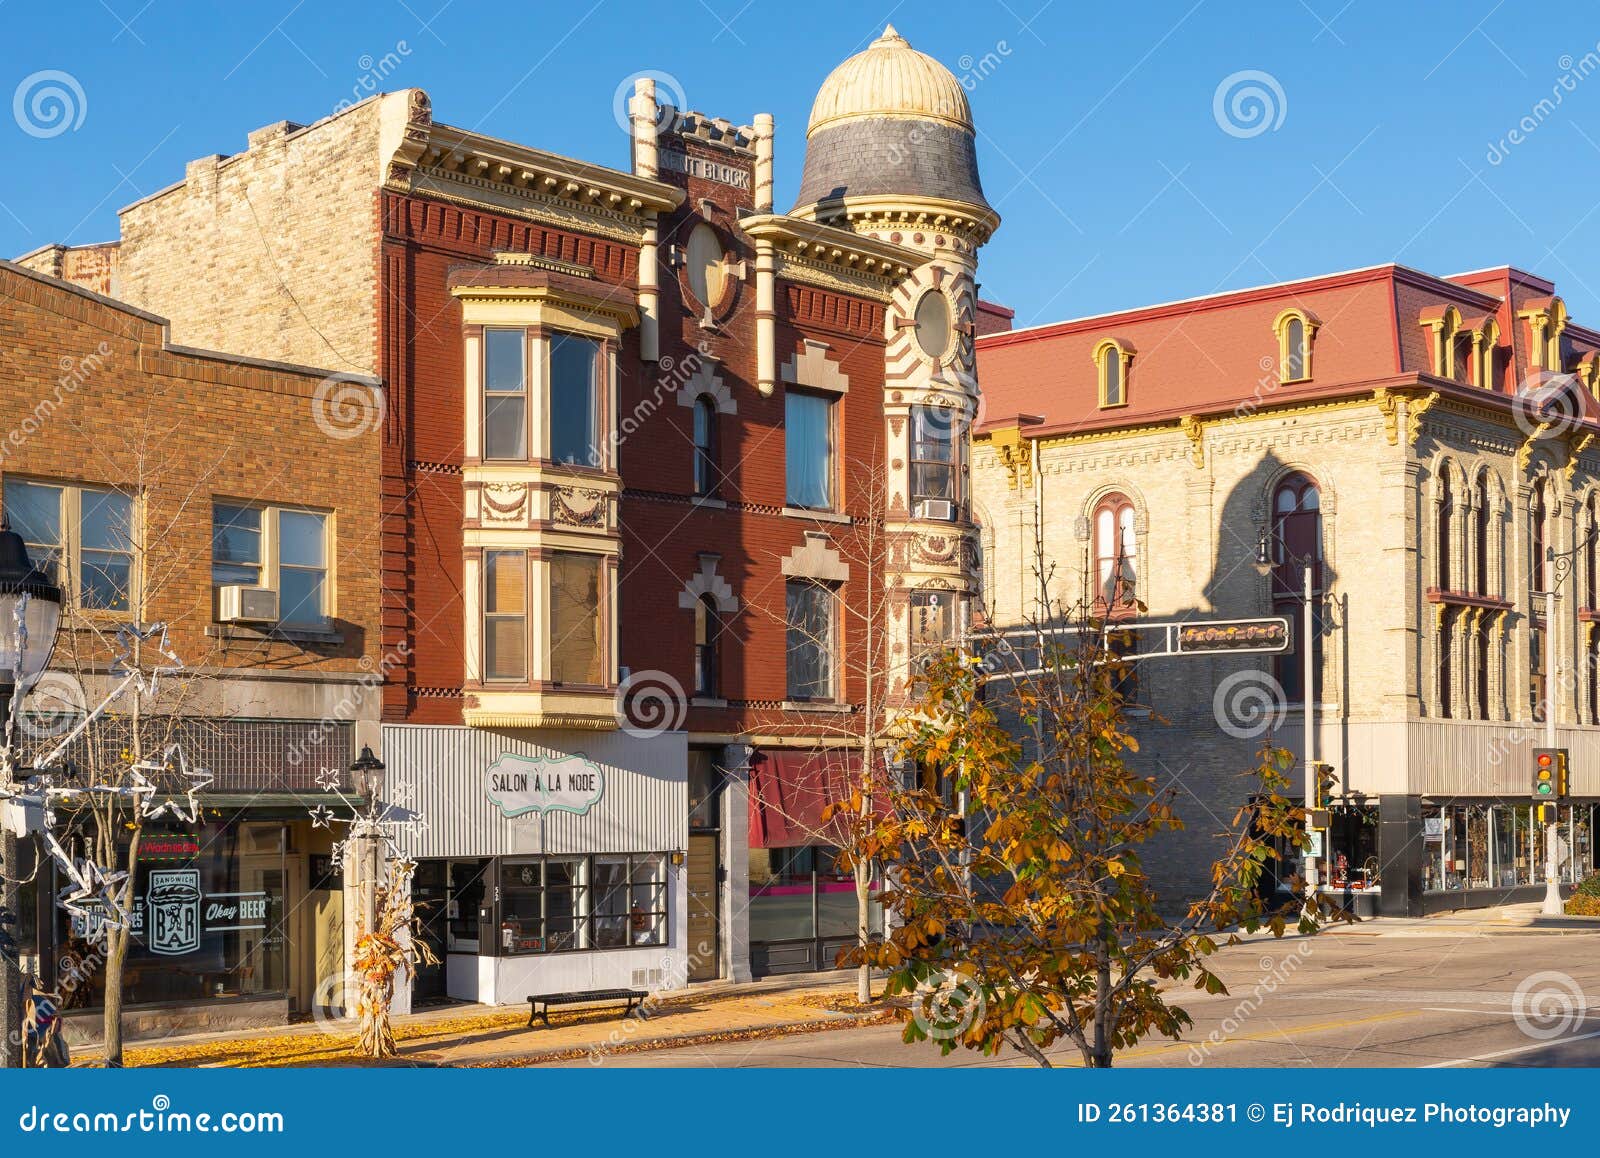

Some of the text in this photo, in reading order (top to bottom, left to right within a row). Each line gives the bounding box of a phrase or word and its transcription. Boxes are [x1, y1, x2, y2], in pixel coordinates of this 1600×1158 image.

[661, 152, 750, 190] KENT BLOCK
[492, 773, 527, 792] SALON
[548, 773, 562, 792] LA
[568, 773, 595, 792] MODE
[154, 875, 195, 886] SANDWICH
[206, 900, 266, 920] Okay BEER
